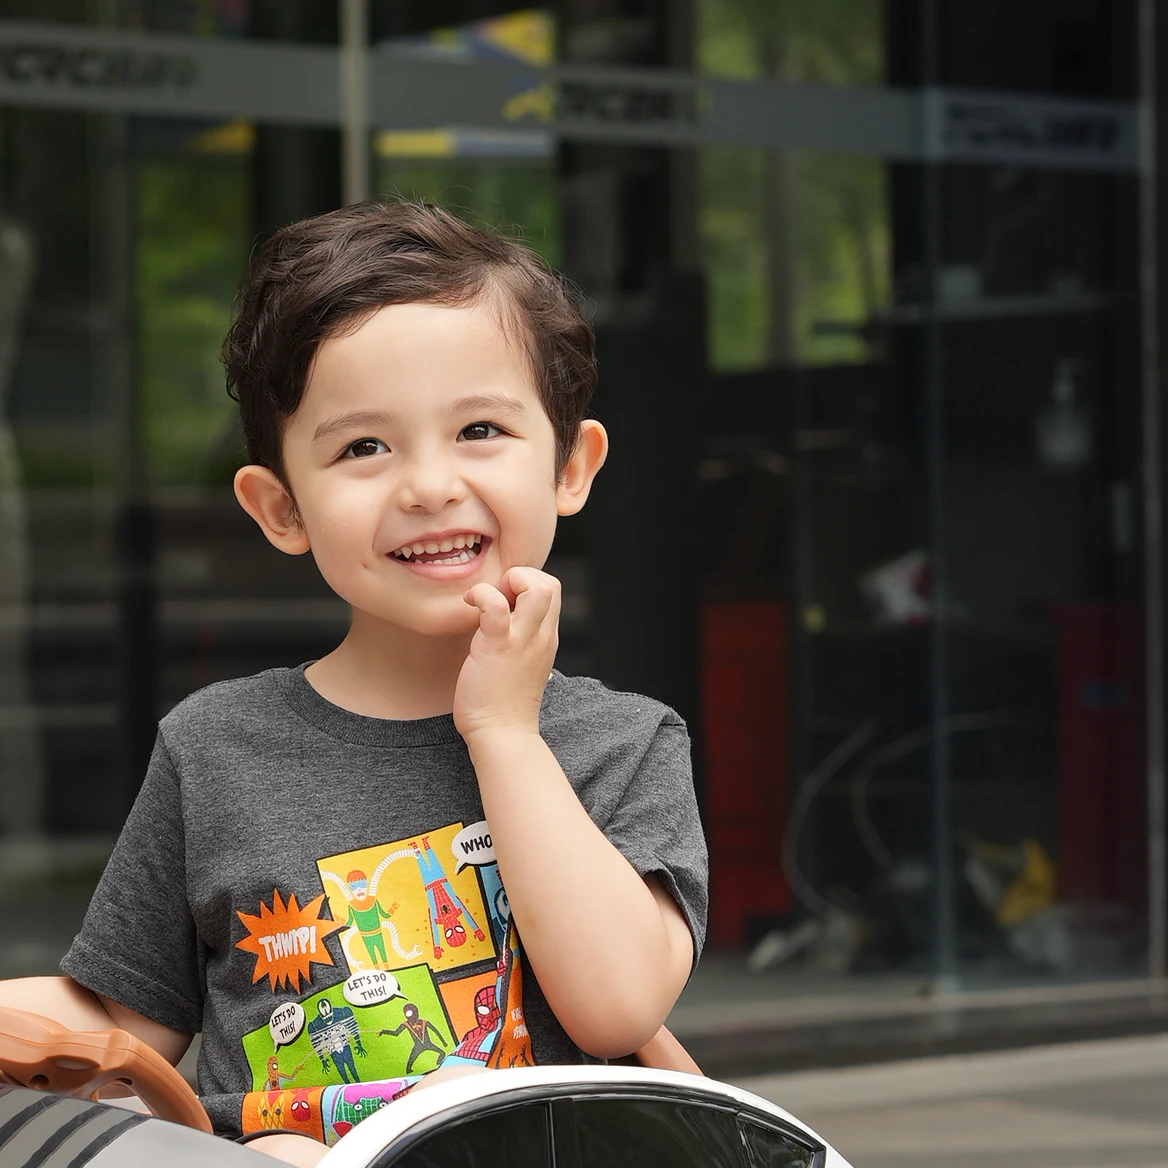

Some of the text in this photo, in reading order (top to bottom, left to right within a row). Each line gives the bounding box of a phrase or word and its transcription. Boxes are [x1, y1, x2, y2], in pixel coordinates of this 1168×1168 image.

[258, 925, 316, 963] THWIP!
[347, 972, 387, 991] LET'S DO
[360, 985, 387, 1002] THIS!
[271, 1005, 296, 1028] LET'S DO
[279, 1020, 296, 1039] THIS!
